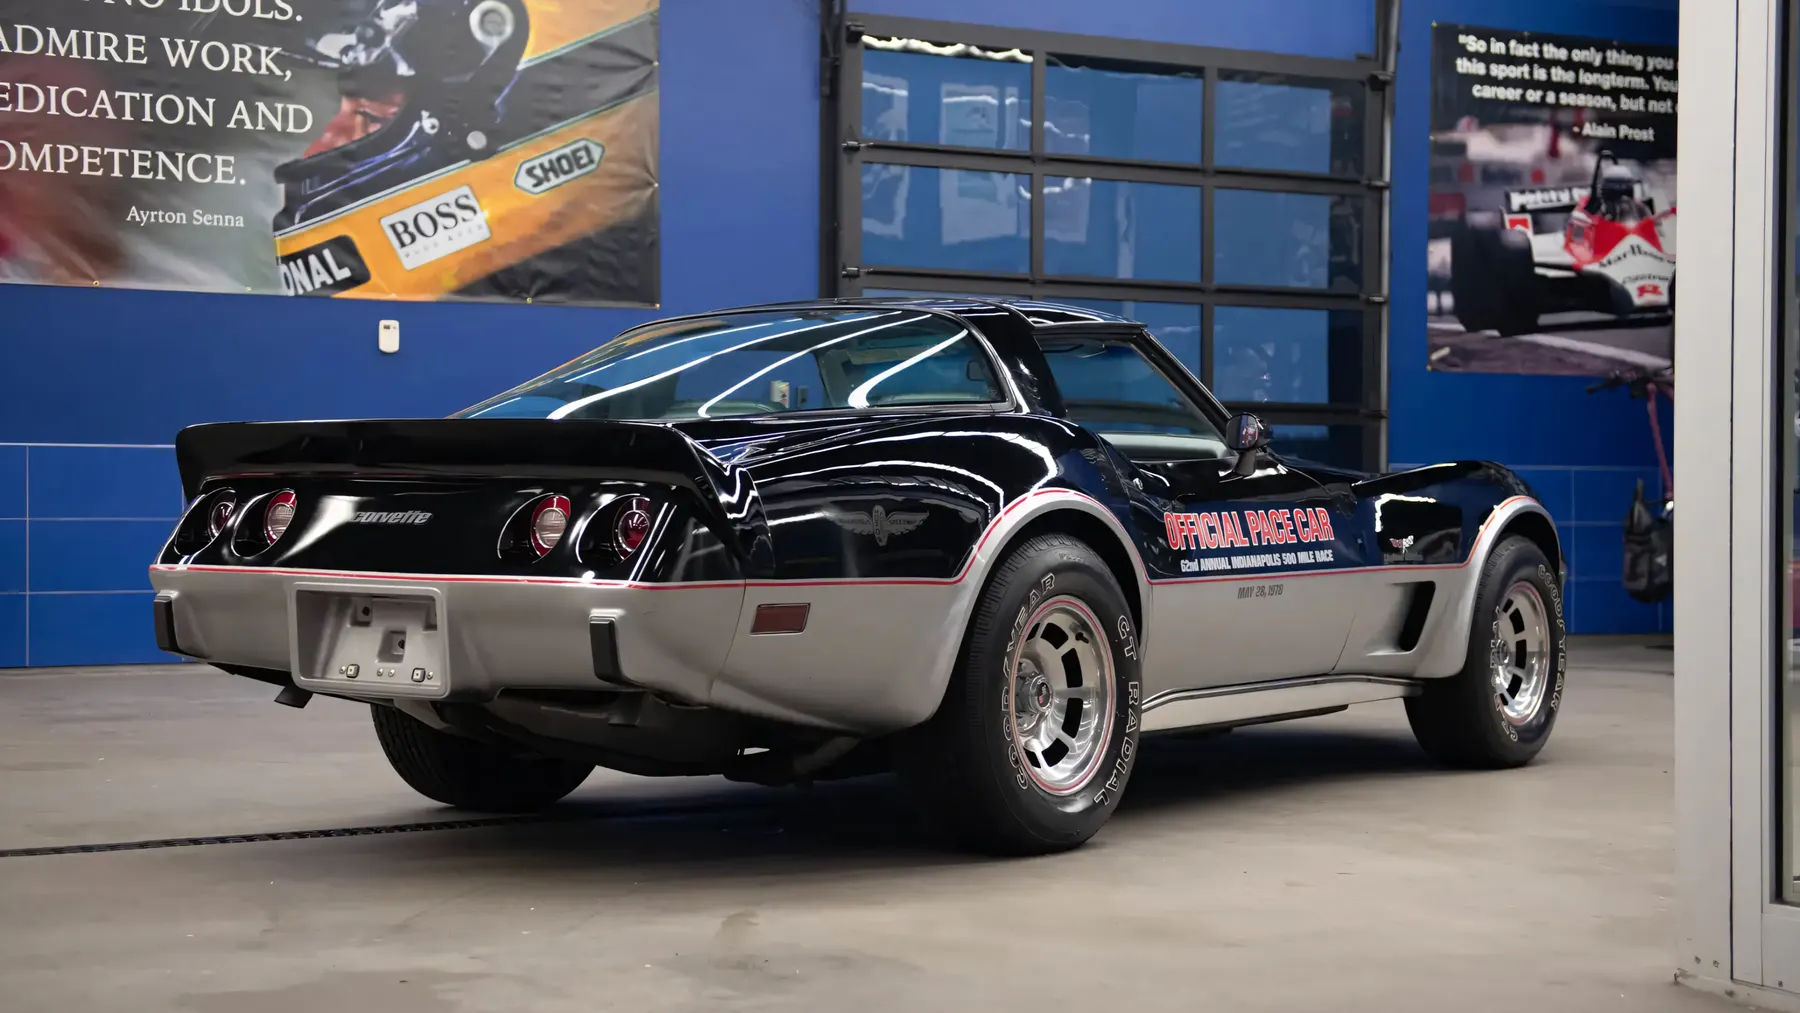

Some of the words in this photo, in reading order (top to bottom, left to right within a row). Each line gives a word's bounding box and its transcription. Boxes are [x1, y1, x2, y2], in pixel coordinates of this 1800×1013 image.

[160, 37, 292, 82] WORK,
[1456, 57, 1487, 76] this
[1489, 63, 1531, 80] sport
[1533, 63, 1549, 82] is
[1550, 66, 1577, 84] the
[1490, 36, 1507, 55] in
[1508, 39, 1541, 58] fact
[1542, 42, 1570, 61] the
[1571, 46, 1603, 67] only
[1605, 49, 1644, 71] thing
[1646, 55, 1675, 72] you
[1472, 83, 1524, 101] career
[1525, 88, 1544, 103] or
[1545, 90, 1556, 104] a
[1559, 91, 1617, 112] season,
[1620, 93, 1646, 112] but
[1648, 98, 1674, 114] not
[227, 99, 313, 134] AND
[1582, 121, 1617, 139] Alain
[1619, 124, 1655, 142] Prost
[525, 144, 595, 188] SHOEI
[126, 205, 187, 227] Ayrton
[192, 209, 244, 227] Senna
[388, 194, 477, 249] BOSS
[1164, 511, 1249, 551] OFFICIAL
[1244, 509, 1297, 547] PACE
[1293, 507, 1335, 545] CAR
[1180, 558, 1200, 573] 62nd
[1200, 557, 1231, 571] ANNUAL
[1231, 553, 1281, 569] INDIANAPOLIS
[1283, 552, 1296, 565] 500
[1297, 550, 1315, 564] MILE
[1316, 549, 1335, 562] RACE
[1237, 585, 1255, 600] MAY
[1117, 614, 1138, 661] GT
[1093, 680, 1140, 807] RADIAL
